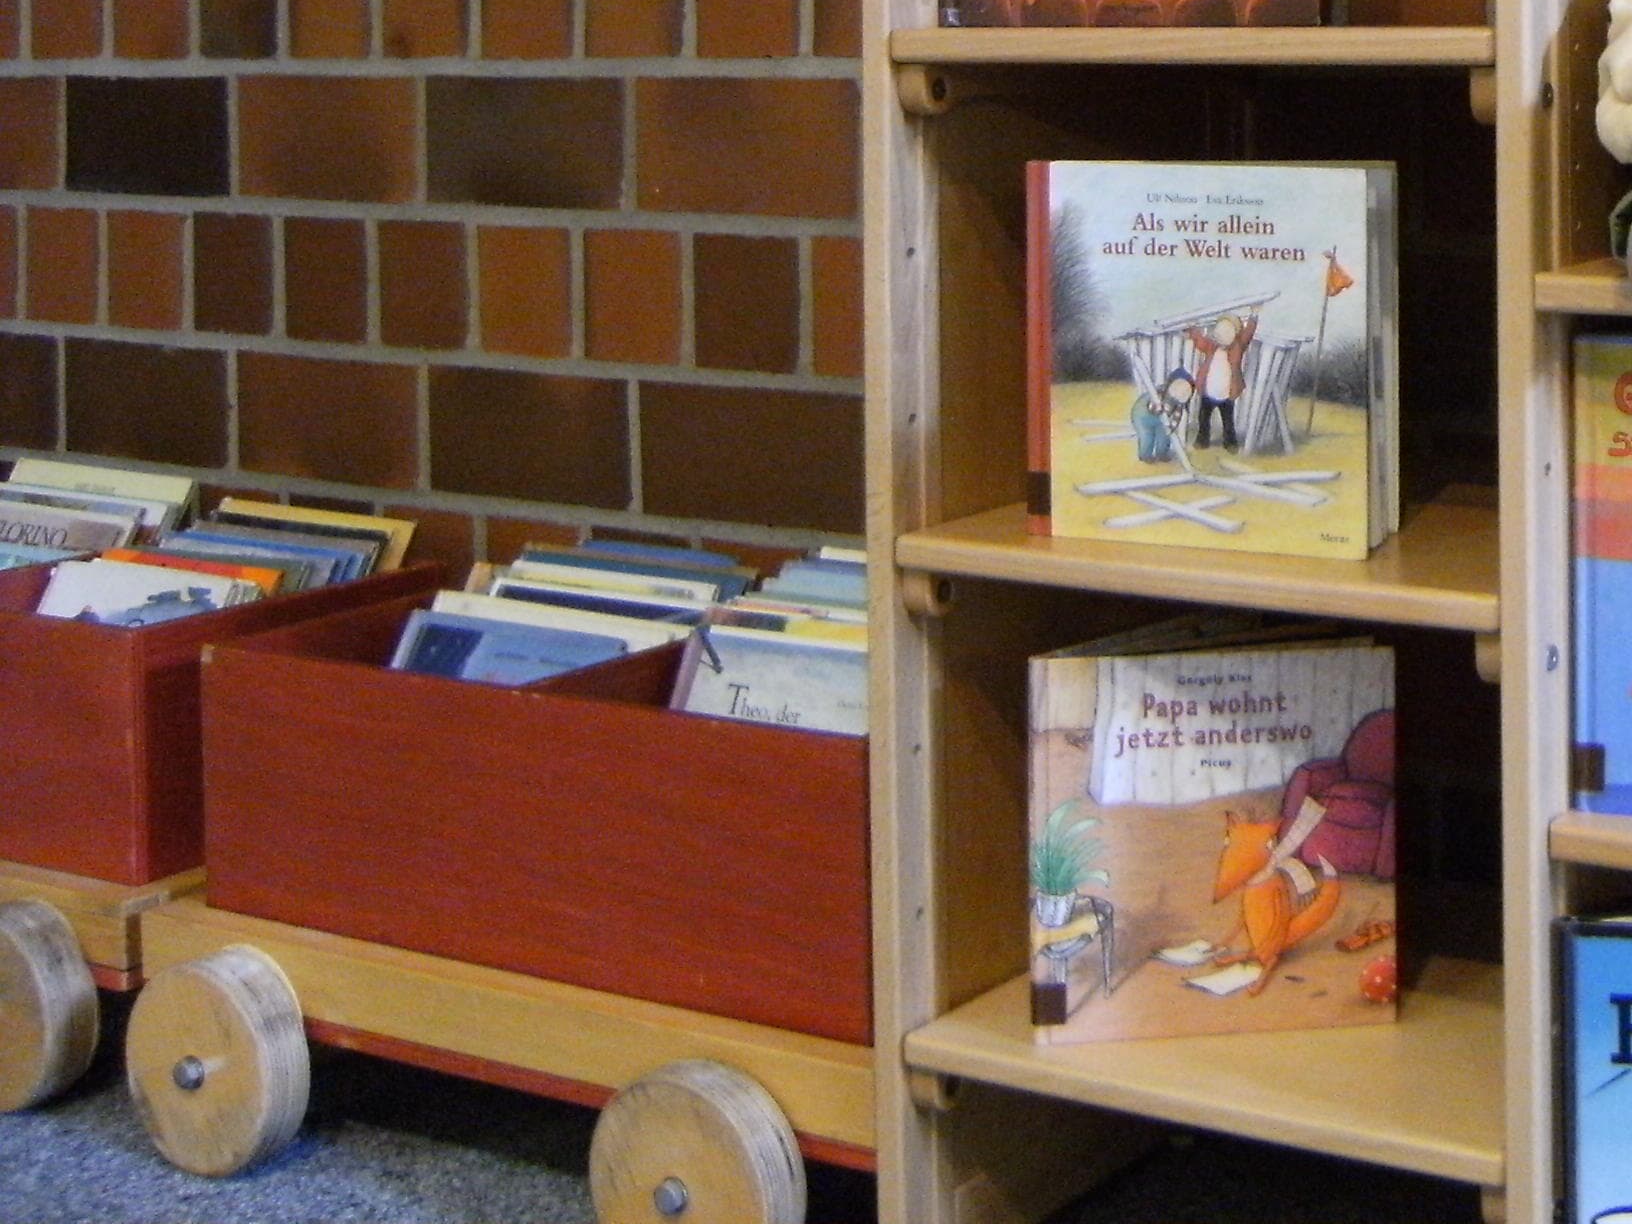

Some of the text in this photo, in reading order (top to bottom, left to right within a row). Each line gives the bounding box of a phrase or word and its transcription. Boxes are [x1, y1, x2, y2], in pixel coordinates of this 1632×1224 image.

[1132, 212, 1276, 236] Als wir allein
[1102, 235, 1306, 262] auf der Welt waren
[1143, 690, 1288, 724] Papa wohnt
[1114, 720, 1313, 758] jetzt anderswo
